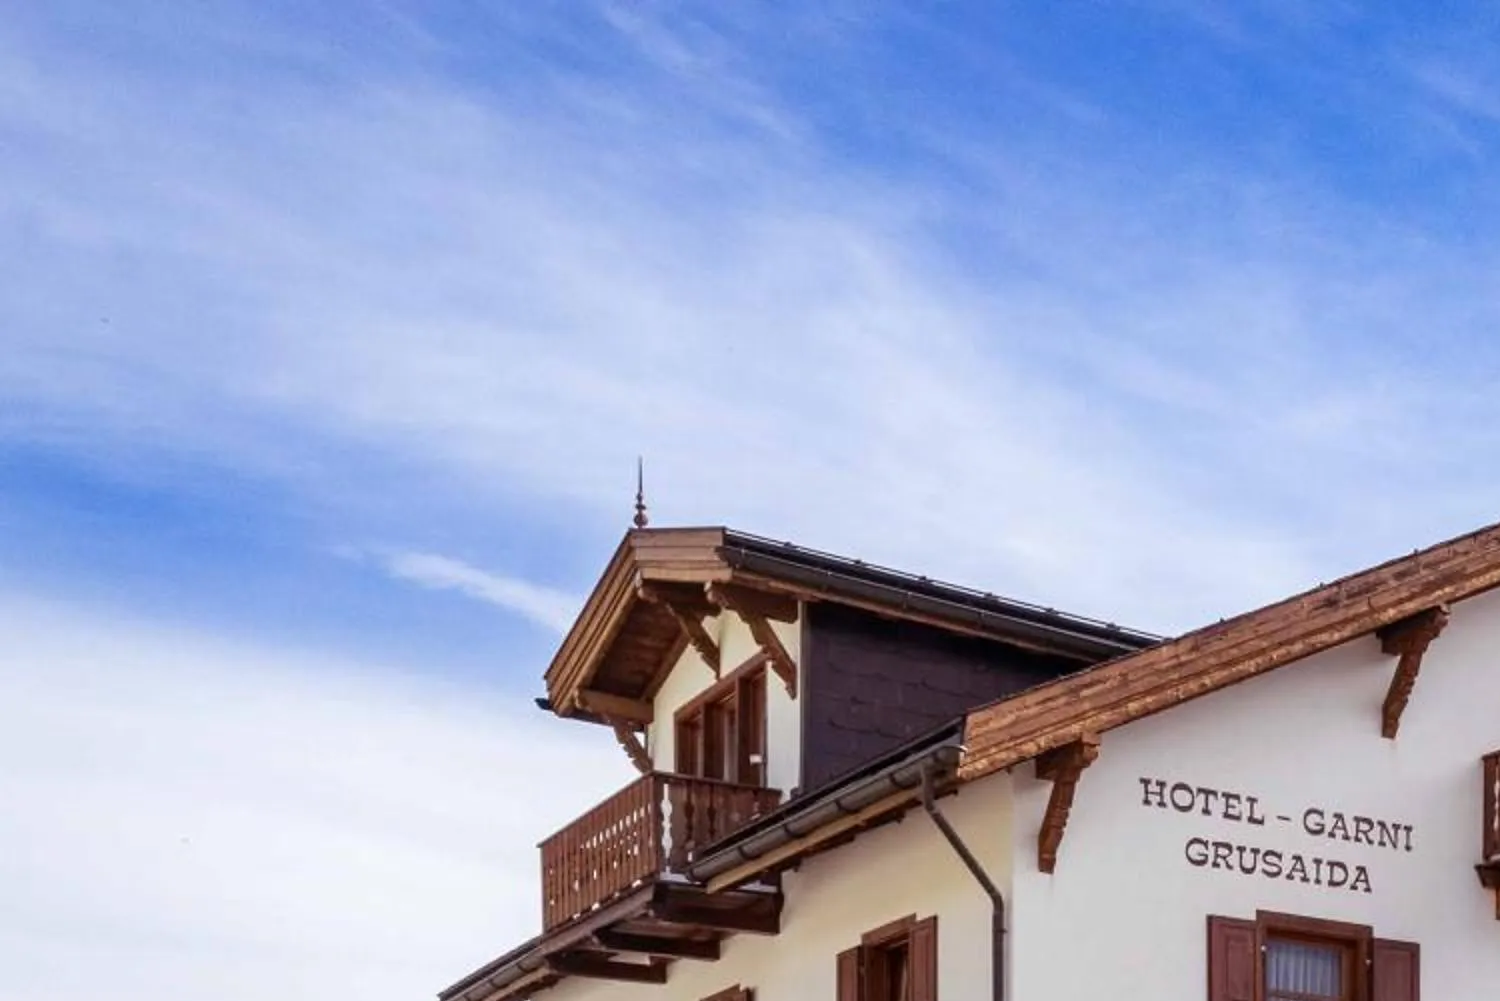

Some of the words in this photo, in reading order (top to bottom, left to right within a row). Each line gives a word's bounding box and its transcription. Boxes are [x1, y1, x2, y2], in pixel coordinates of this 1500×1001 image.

[1139, 778, 1265, 825] HOTEL
[1303, 808, 1413, 852] GARNI
[1185, 837, 1373, 893] GRUSAIDA
